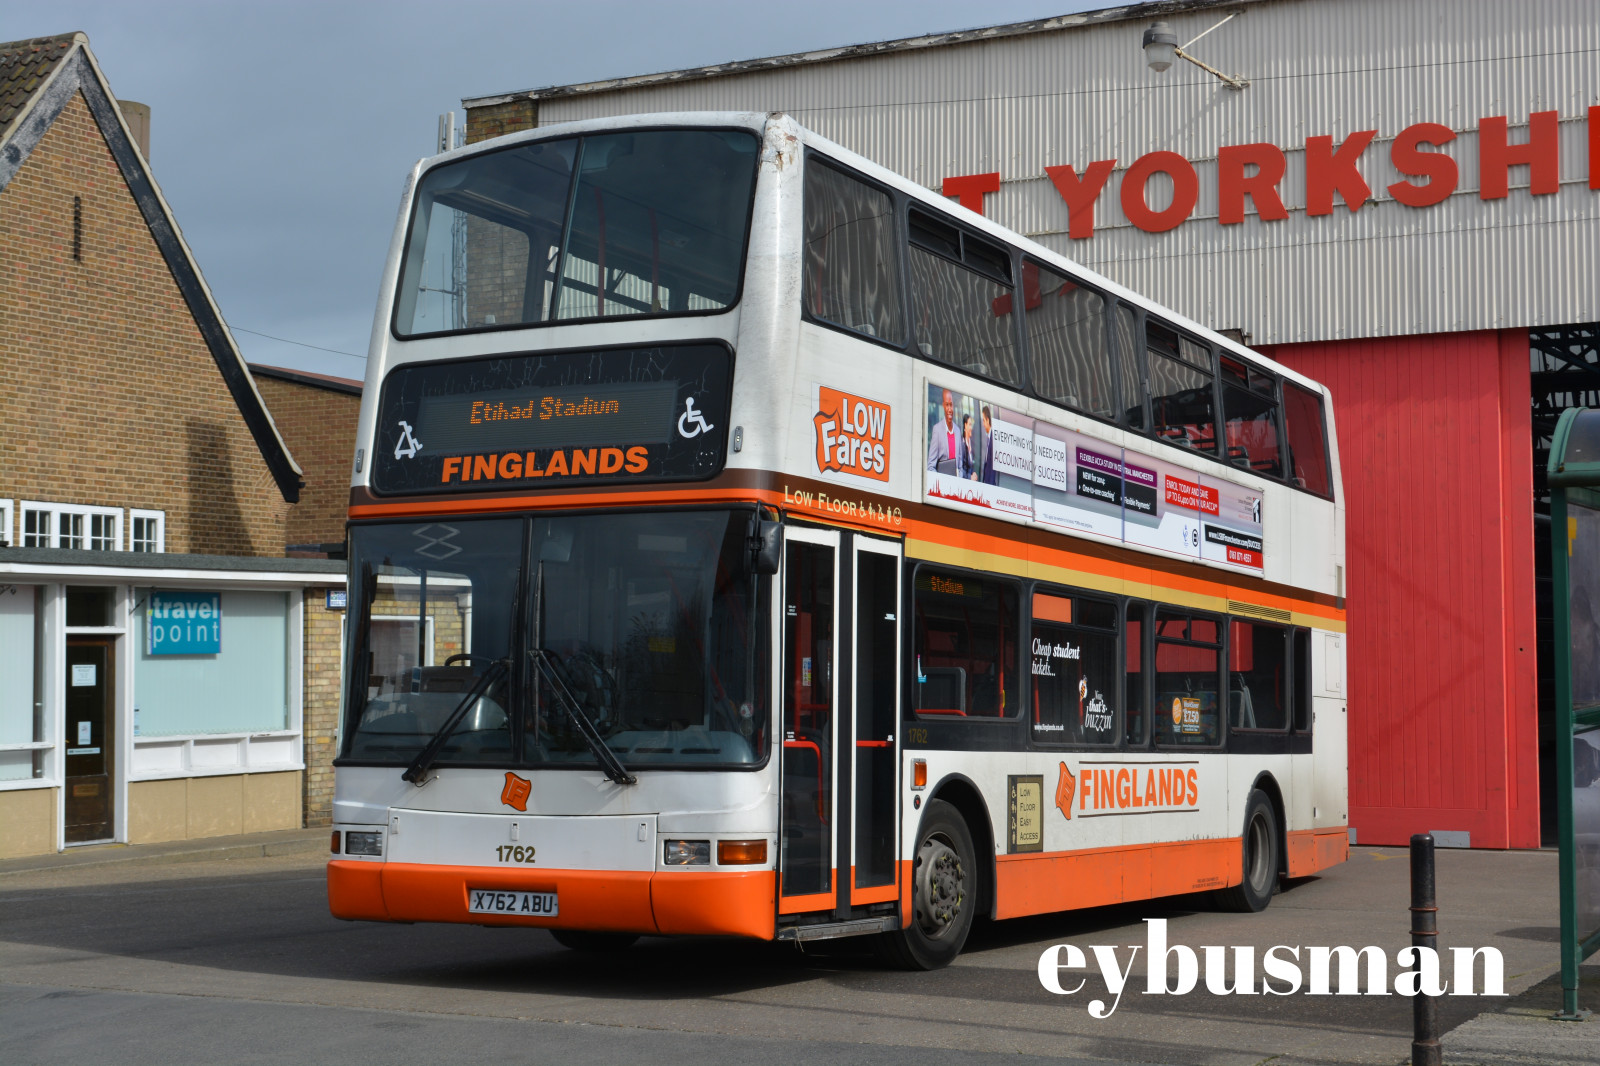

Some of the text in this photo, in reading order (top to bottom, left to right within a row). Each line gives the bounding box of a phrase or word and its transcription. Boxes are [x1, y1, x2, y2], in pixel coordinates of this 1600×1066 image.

[470, 396, 619, 424] Etihad Stadium
[843, 398, 887, 441] LOW
[821, 420, 885, 474] Fares
[994, 429, 1026, 448] EVERYTHING
[1038, 446, 1053, 459] NEED
[1053, 450, 1065, 462] FOR
[441, 446, 649, 483] FINGLANDS
[994, 450, 1065, 483] ACCOUNTANCY SUCCESS
[1166, 479, 1178, 492] ENROL
[1178, 483, 1192, 495] TODAY
[153, 597, 218, 619] travel
[153, 619, 219, 648] point
[1032, 638, 1080, 661] Cheap student
[908, 728, 928, 744] 1762
[1079, 768, 1198, 810] FINGLANDS
[495, 845, 536, 863] 1762
[475, 892, 554, 913] X762 ABU
